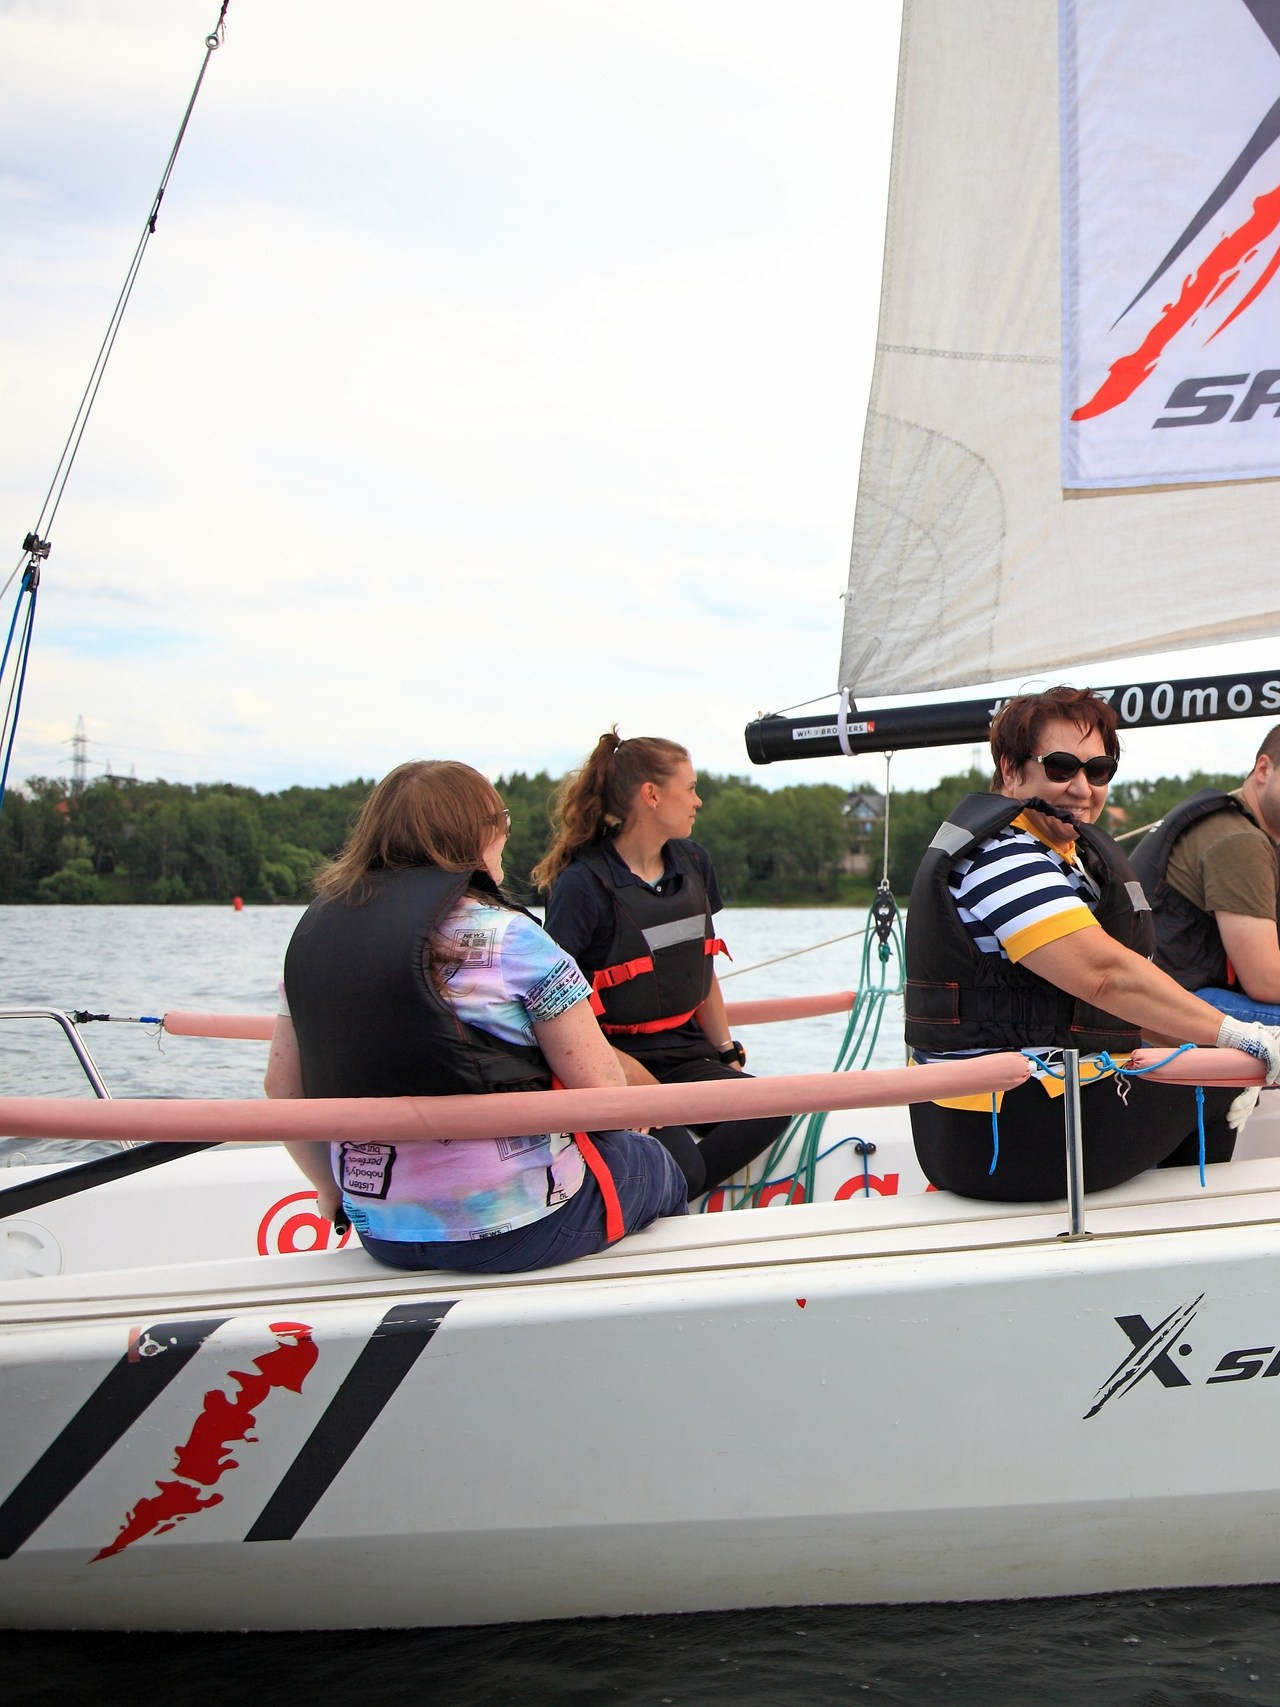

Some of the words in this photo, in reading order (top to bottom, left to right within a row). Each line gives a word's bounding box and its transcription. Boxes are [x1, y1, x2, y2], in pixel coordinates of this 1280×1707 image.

[821, 725, 864, 735] BROERS
[345, 1166, 384, 1179] nobody's
[349, 1179, 375, 1192] Listen
